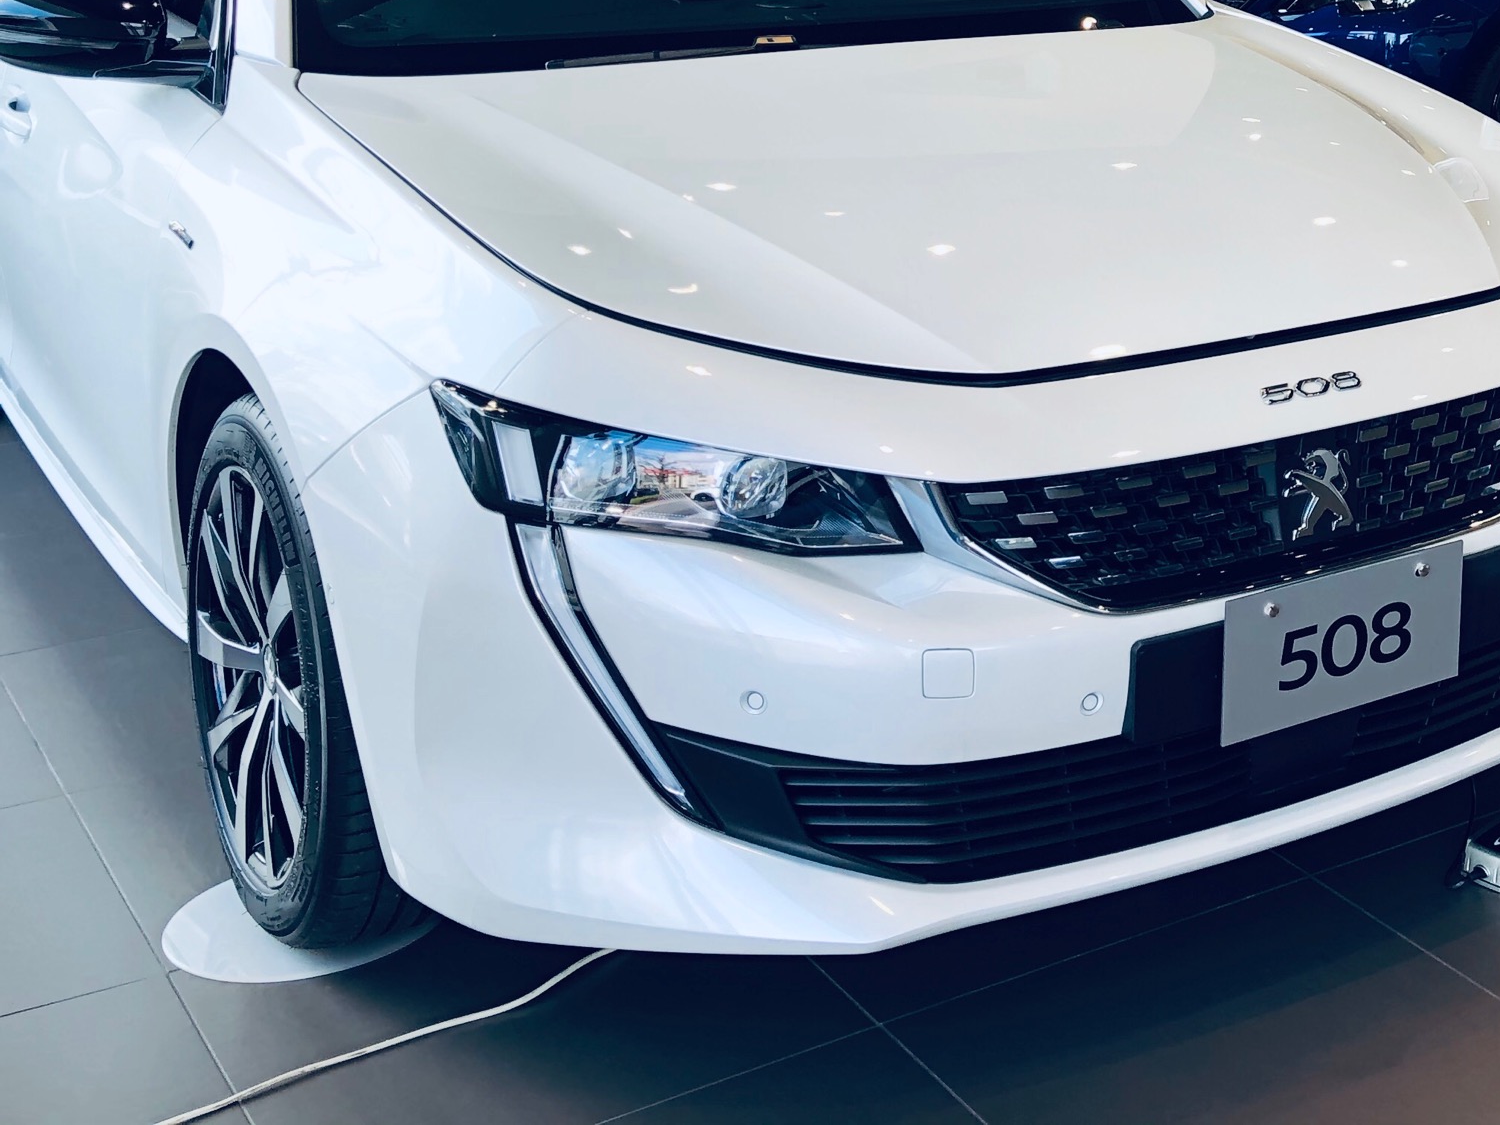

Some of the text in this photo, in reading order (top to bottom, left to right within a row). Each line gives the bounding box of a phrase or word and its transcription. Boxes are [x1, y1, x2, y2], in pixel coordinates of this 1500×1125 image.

[1260, 370, 1363, 406] 508
[254, 457, 297, 565] MICHELIN
[1278, 601, 1412, 692] 508
